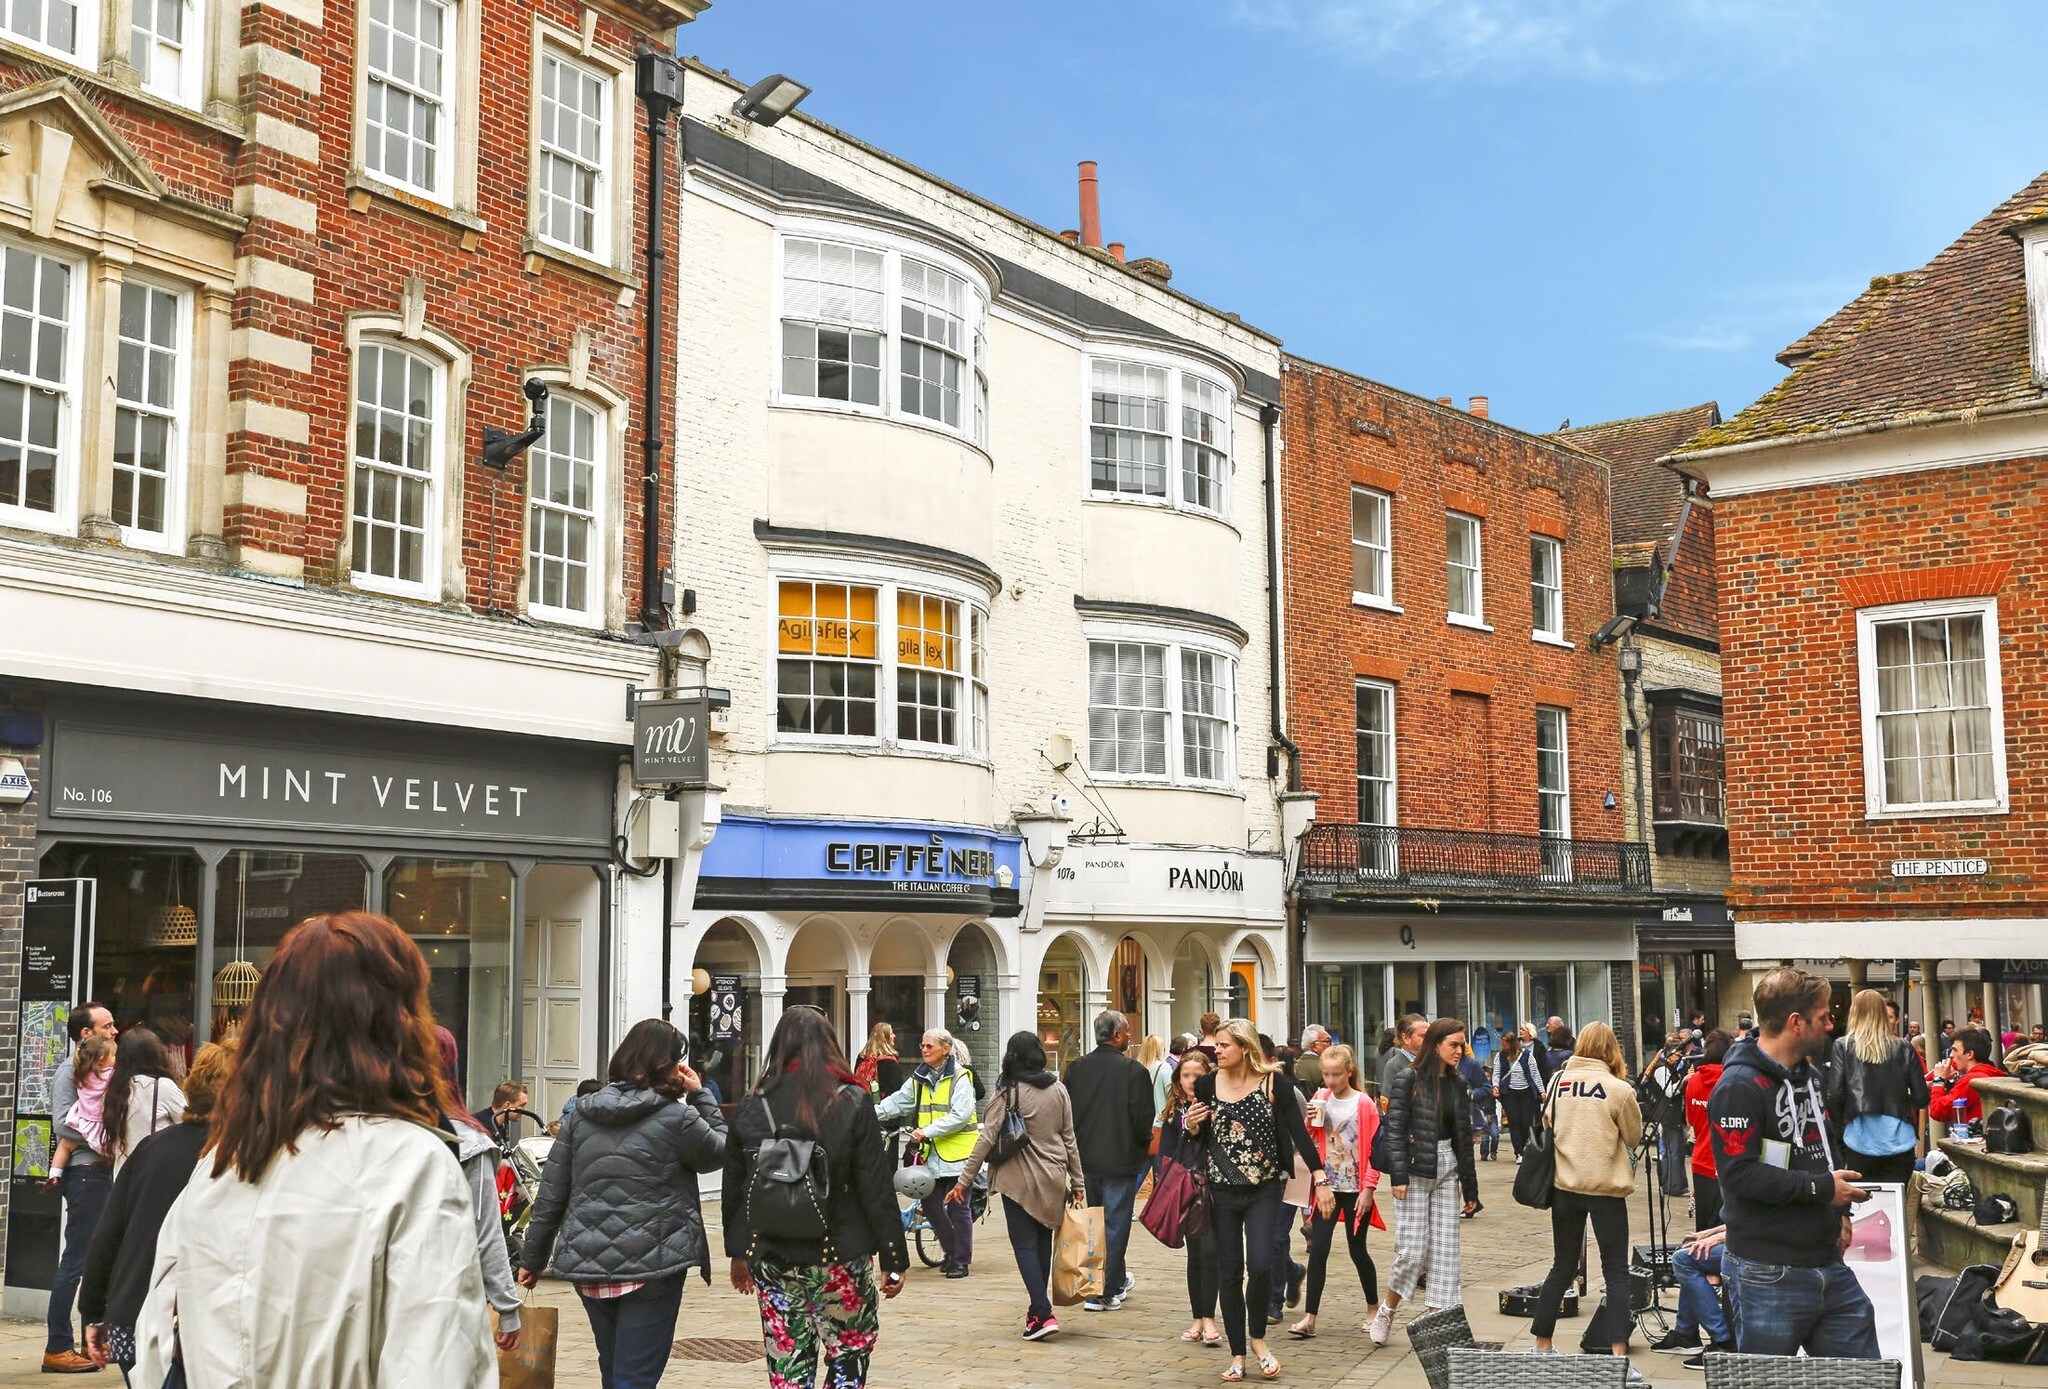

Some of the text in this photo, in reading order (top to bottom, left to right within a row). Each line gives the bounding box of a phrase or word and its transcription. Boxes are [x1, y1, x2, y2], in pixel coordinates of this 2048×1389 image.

[779, 619, 861, 643] Agilaflex
[1, 776, 27, 785] AXIS
[63, 787, 113, 803] No. 106
[219, 763, 528, 817] MINT VELVET
[1057, 867, 1076, 880] 107a
[1926, 860, 1985, 874] PENTICE
[892, 881, 909, 892] THE
[910, 882, 940, 893] ITALIAN
[941, 883, 963, 894] COFFEE
[1558, 1081, 1607, 1099] FILA
